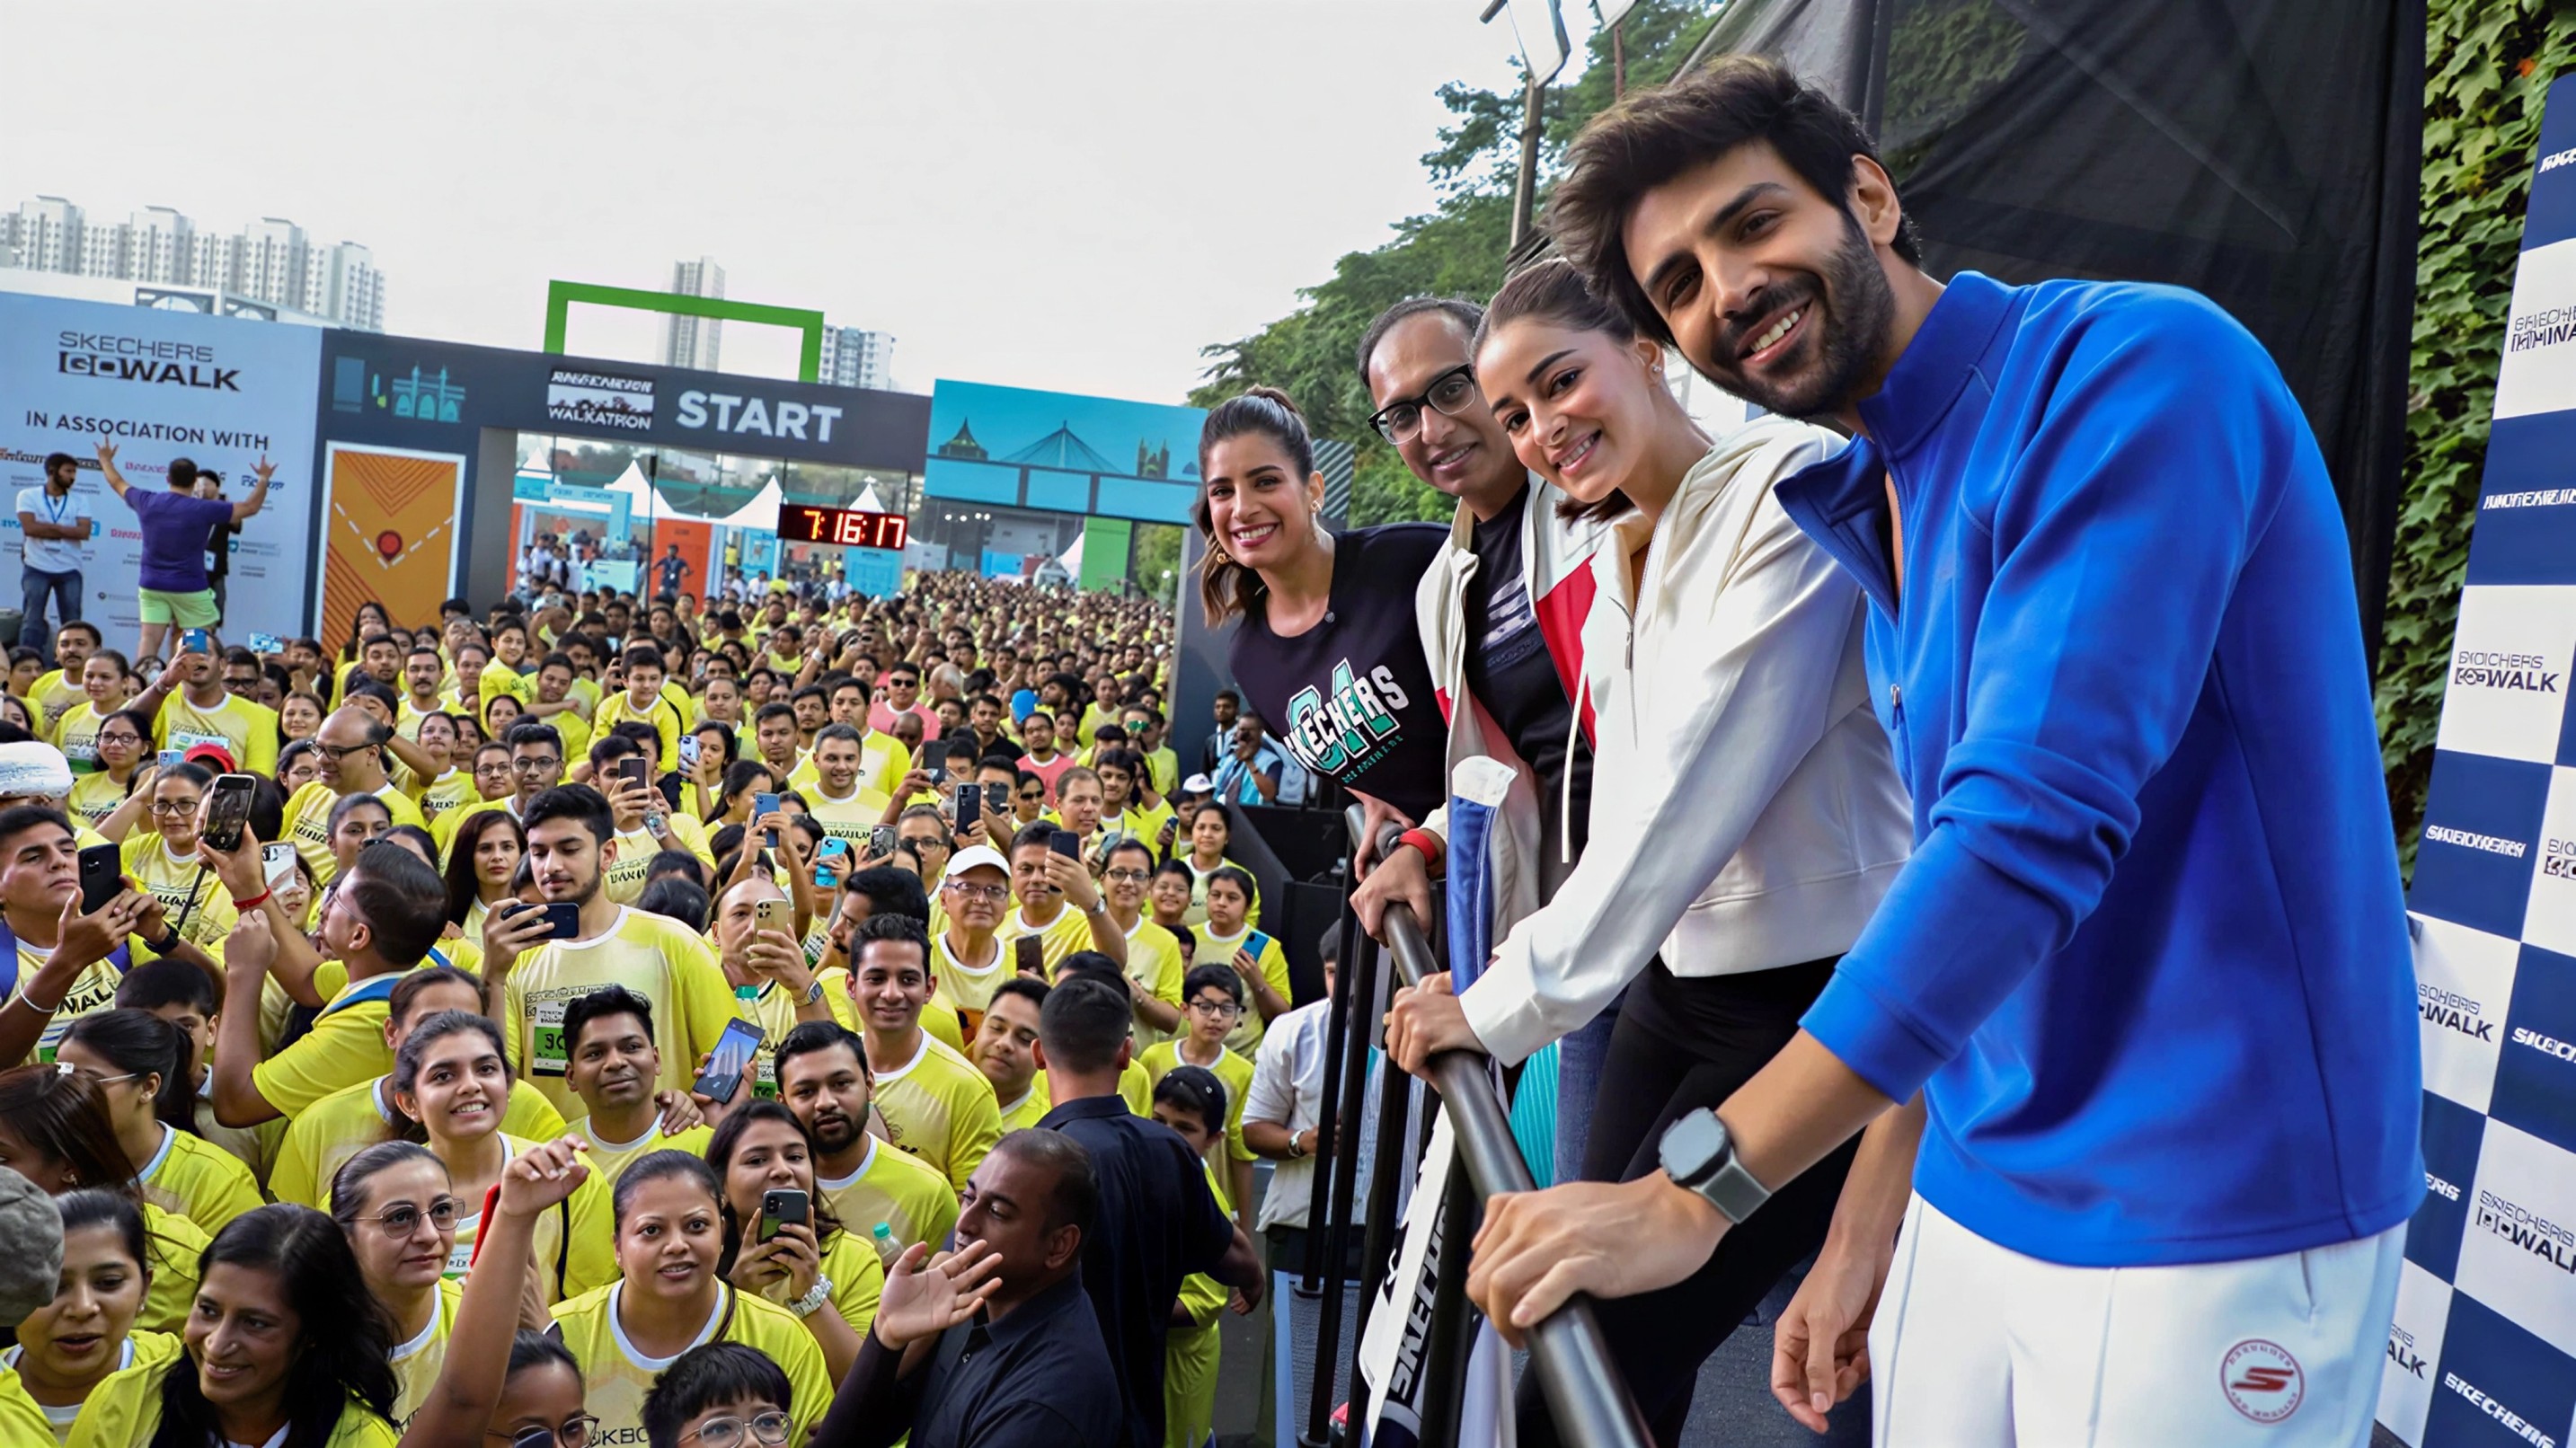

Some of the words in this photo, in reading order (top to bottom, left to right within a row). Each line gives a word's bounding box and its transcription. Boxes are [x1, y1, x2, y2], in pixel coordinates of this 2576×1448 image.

[58, 331, 214, 362] SKECHERS
[25, 411, 48, 428] IN
[56, 414, 204, 444] ASSOCIATION
[212, 430, 269, 450] WITH
[676, 390, 843, 443] START
